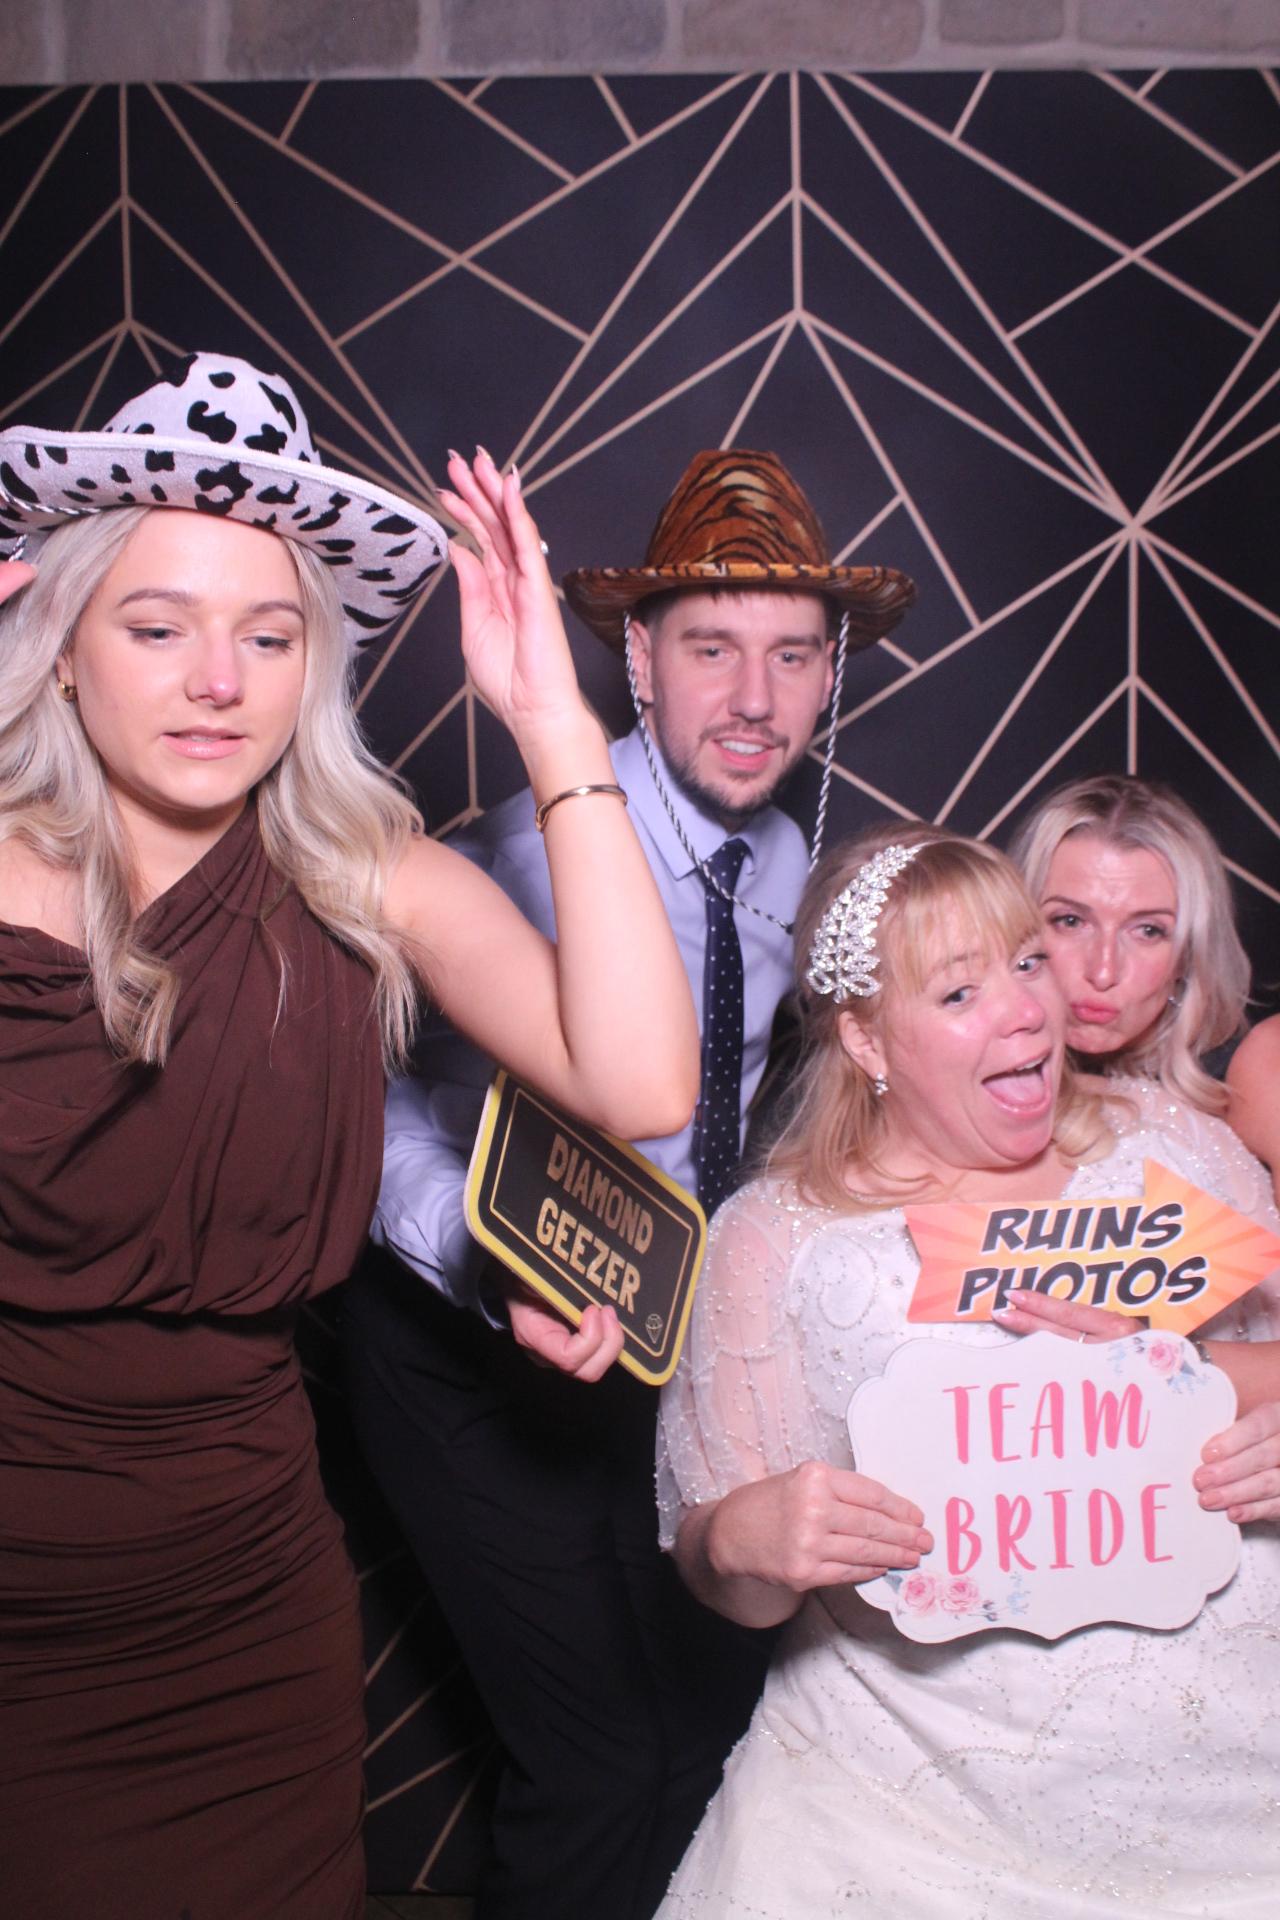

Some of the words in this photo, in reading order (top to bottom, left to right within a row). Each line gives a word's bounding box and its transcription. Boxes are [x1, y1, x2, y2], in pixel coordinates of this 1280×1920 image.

[546, 1133, 654, 1254] DIAMOND
[981, 1203, 1183, 1252] RUINS
[536, 1198, 641, 1314] GEEZER
[957, 1257, 1206, 1312] PHOTOS
[943, 1380, 1150, 1464] TEAM
[945, 1484, 1173, 1575] BRIDE
